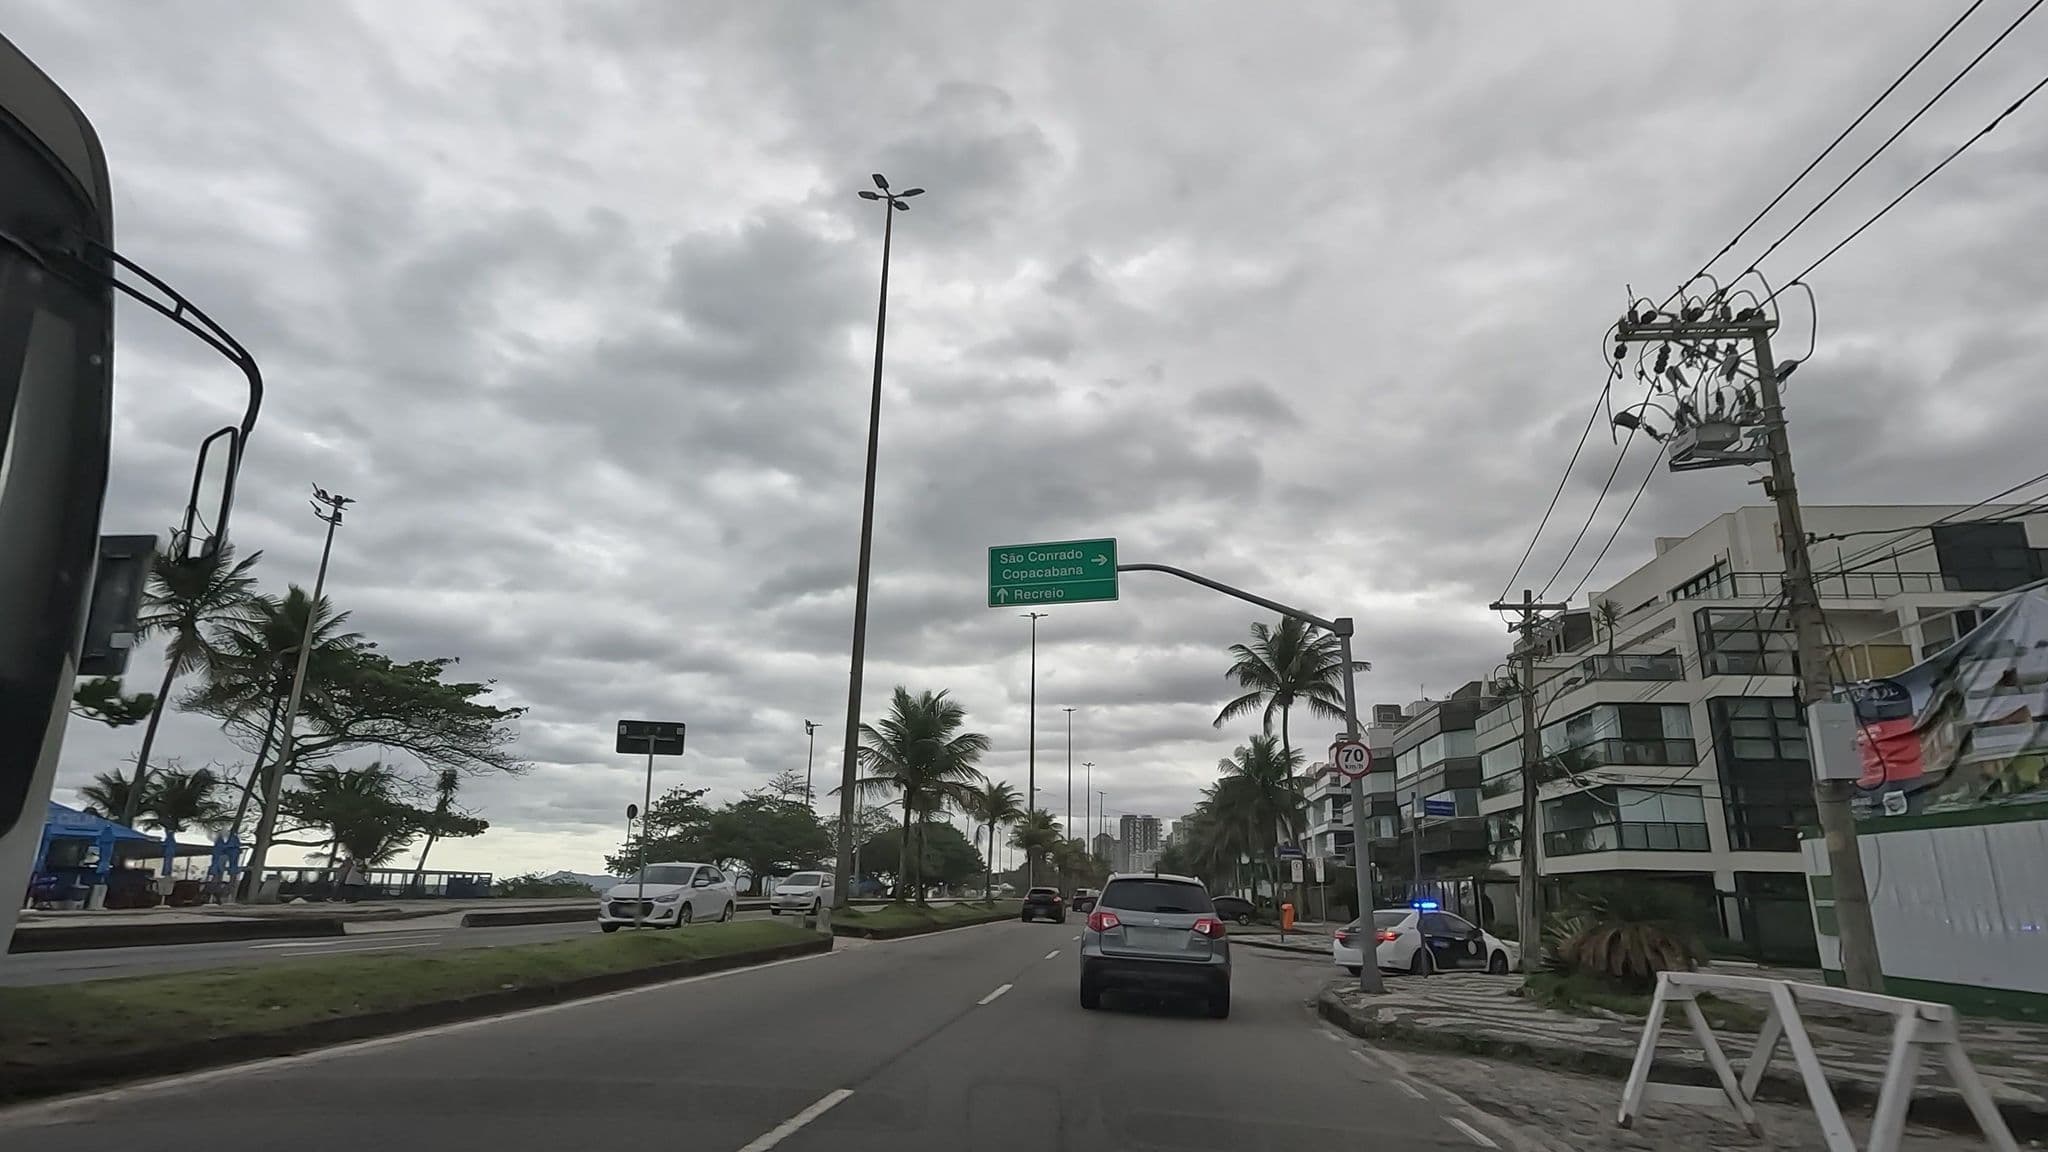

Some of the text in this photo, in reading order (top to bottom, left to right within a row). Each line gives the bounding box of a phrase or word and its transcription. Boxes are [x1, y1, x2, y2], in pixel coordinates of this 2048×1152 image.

[1000, 549, 1083, 564] São Conrado
[1002, 566, 1083, 580] Copacabana
[1014, 588, 1064, 600] Recreio
[1343, 749, 1363, 762] 70
